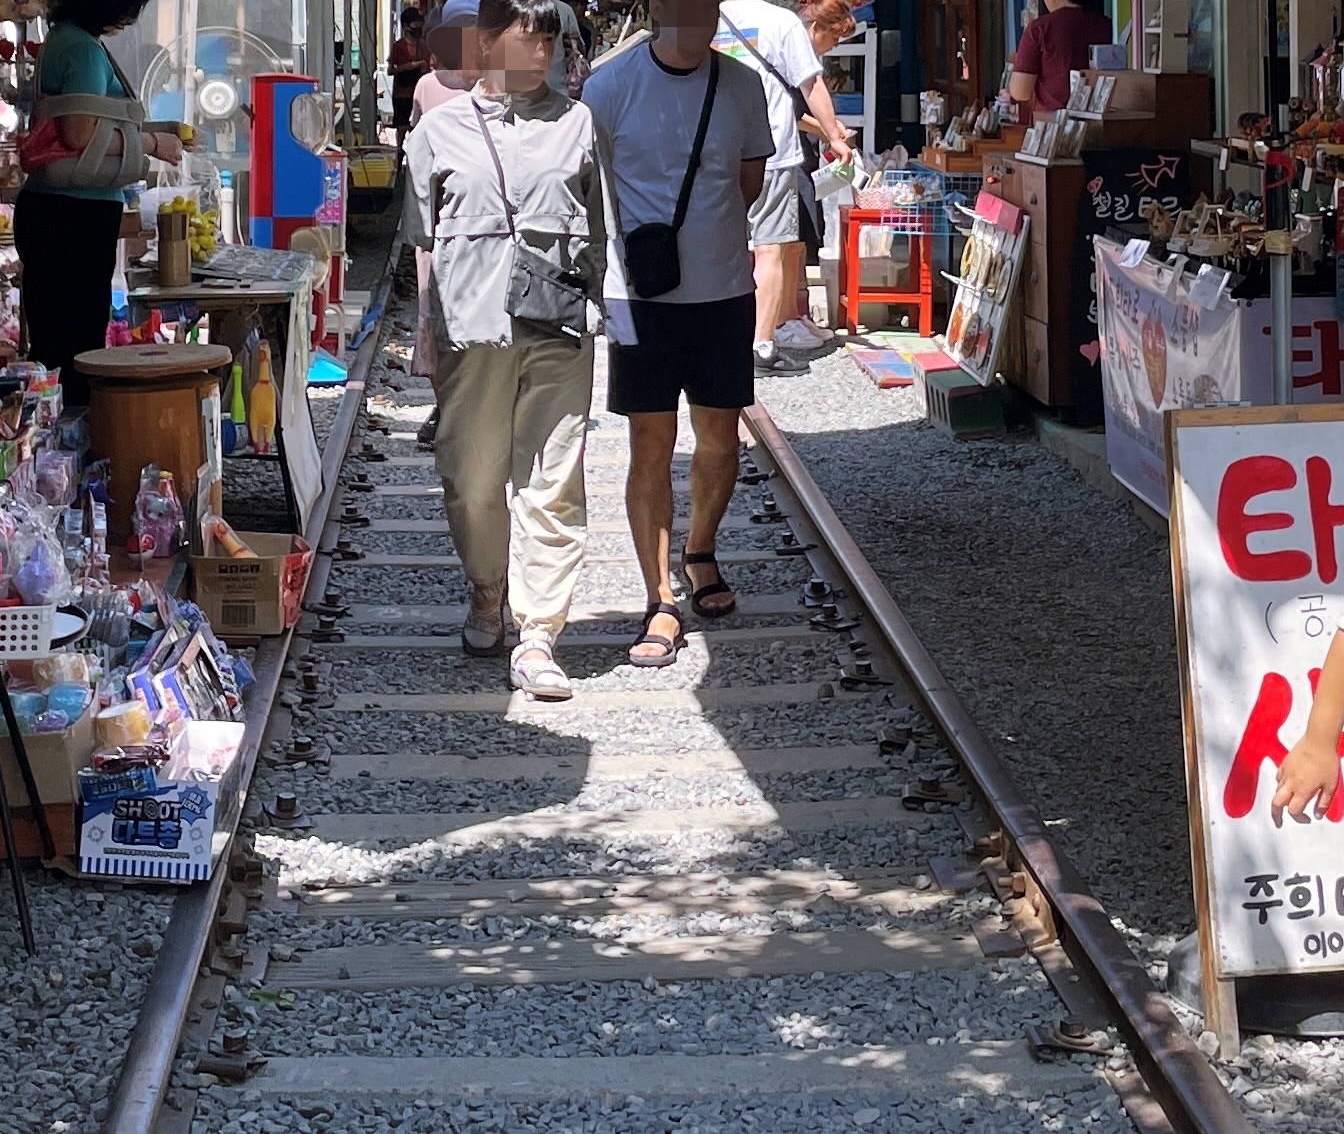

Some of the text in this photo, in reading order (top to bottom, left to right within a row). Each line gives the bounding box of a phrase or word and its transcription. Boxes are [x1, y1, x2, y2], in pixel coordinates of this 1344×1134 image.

[114, 797, 183, 821] SHOOT
[113, 819, 182, 849] 다트총
[1242, 872, 1325, 925] 주희
